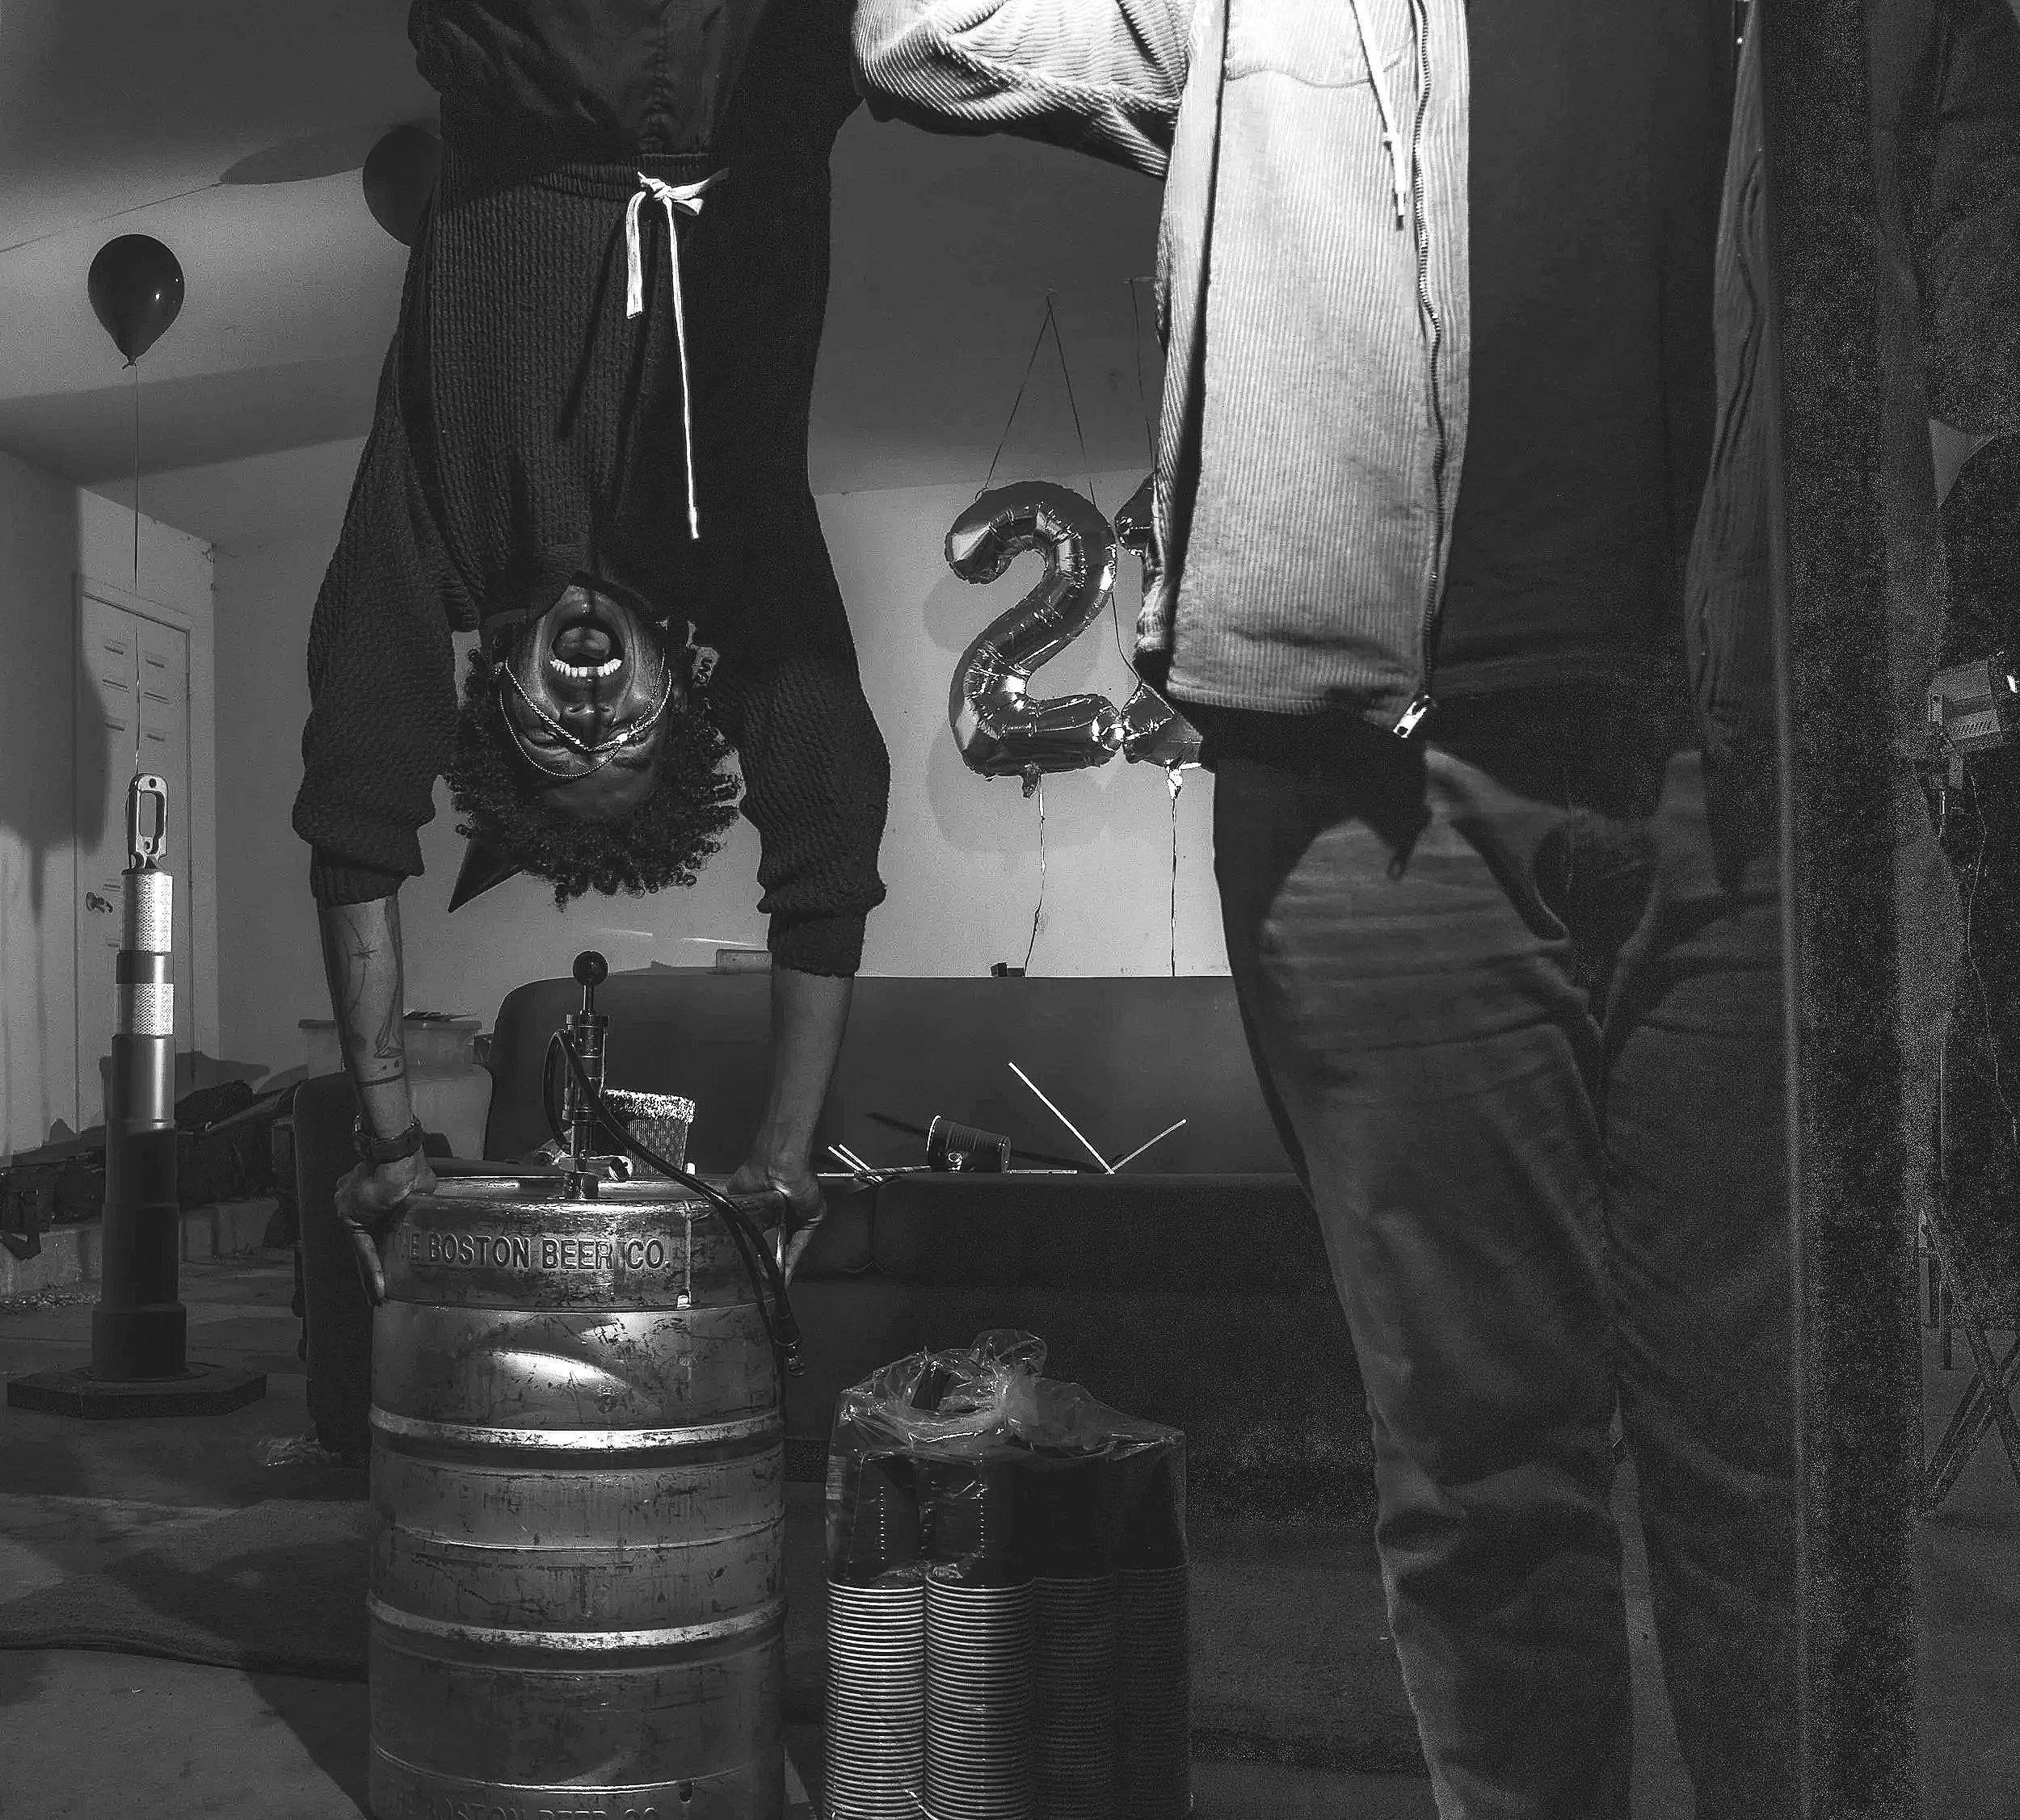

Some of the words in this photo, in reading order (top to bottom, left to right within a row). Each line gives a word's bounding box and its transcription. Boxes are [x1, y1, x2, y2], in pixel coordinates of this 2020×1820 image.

[427, 1232, 531, 1268] BOSTON
[542, 1238, 613, 1270] BEER
[625, 1238, 671, 1270] CO.
